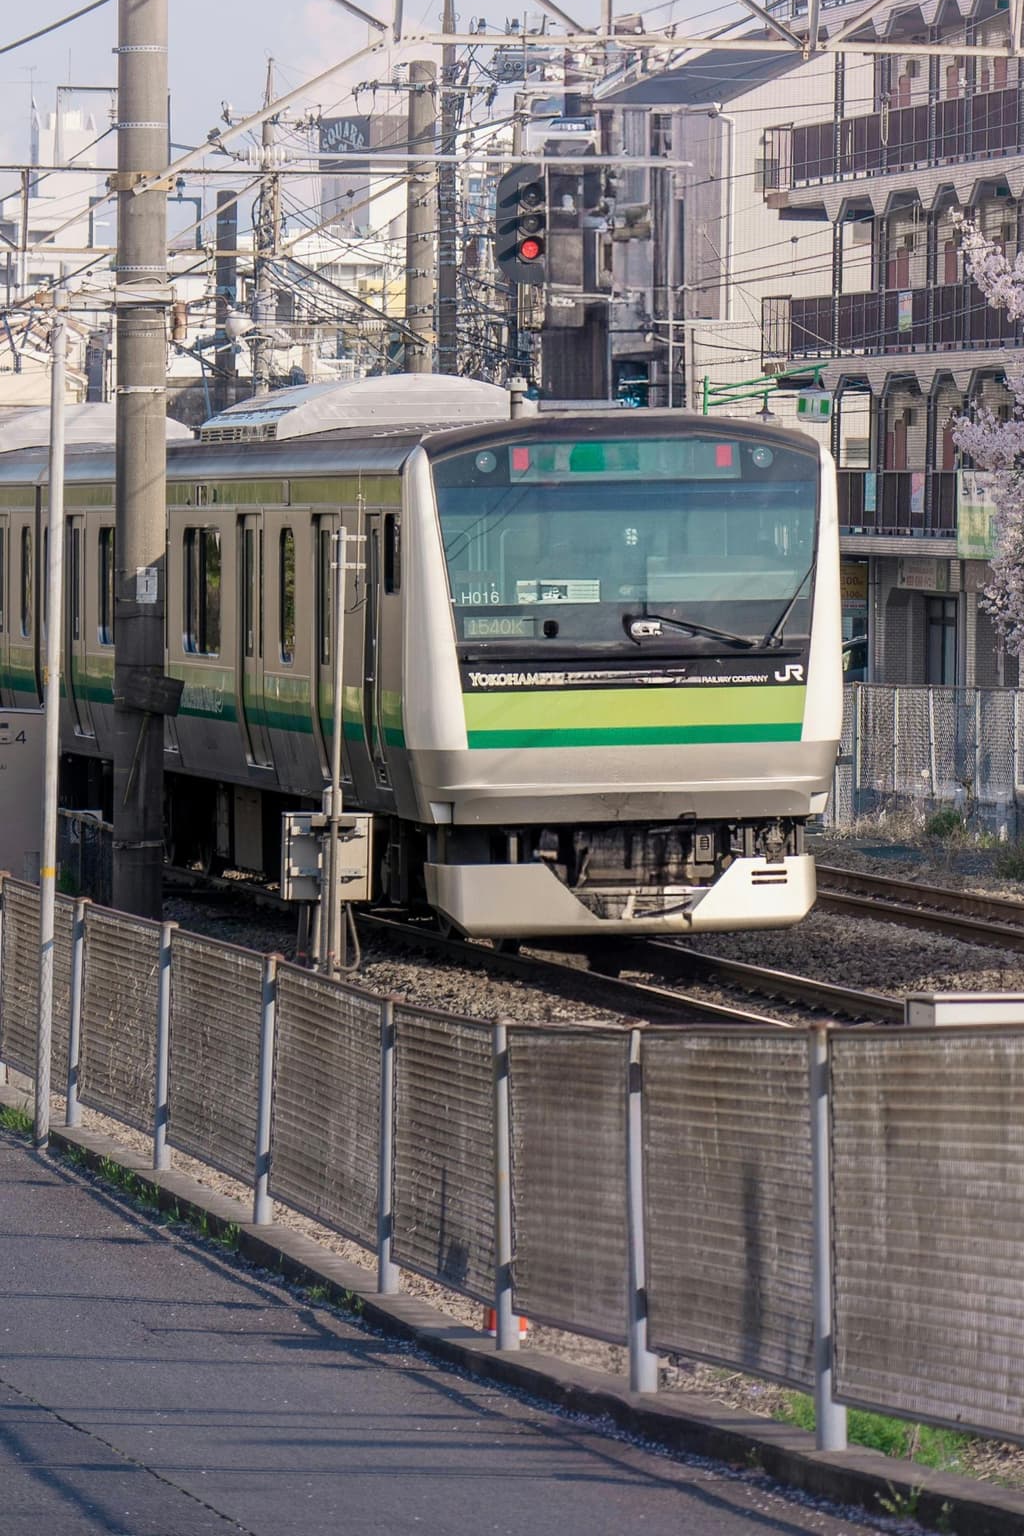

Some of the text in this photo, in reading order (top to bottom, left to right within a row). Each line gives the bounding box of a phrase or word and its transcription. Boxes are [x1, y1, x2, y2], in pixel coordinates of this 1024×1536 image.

[461, 591, 500, 605] H016
[732, 674, 769, 683] COMPANY
[774, 664, 804, 682] JR
[15, 730, 27, 745] 4
